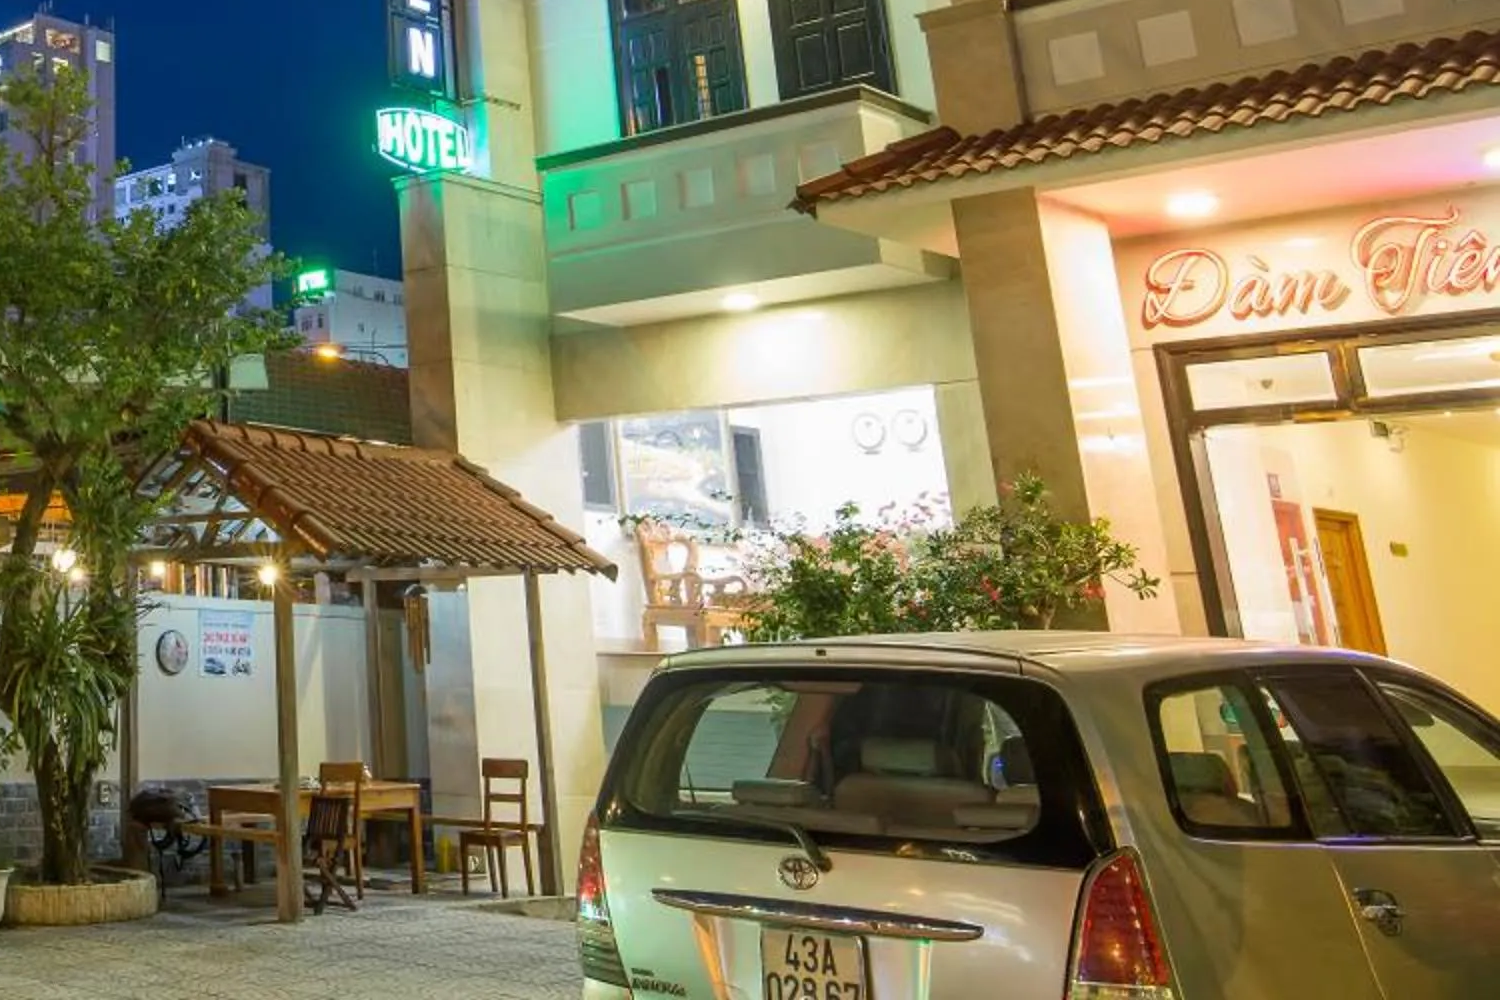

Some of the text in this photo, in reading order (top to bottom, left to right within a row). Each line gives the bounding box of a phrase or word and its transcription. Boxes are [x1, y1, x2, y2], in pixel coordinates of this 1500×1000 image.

[380, 110, 473, 170] HOTEL
[1142, 248, 1351, 330] Đàm
[785, 933, 838, 977] 43A
